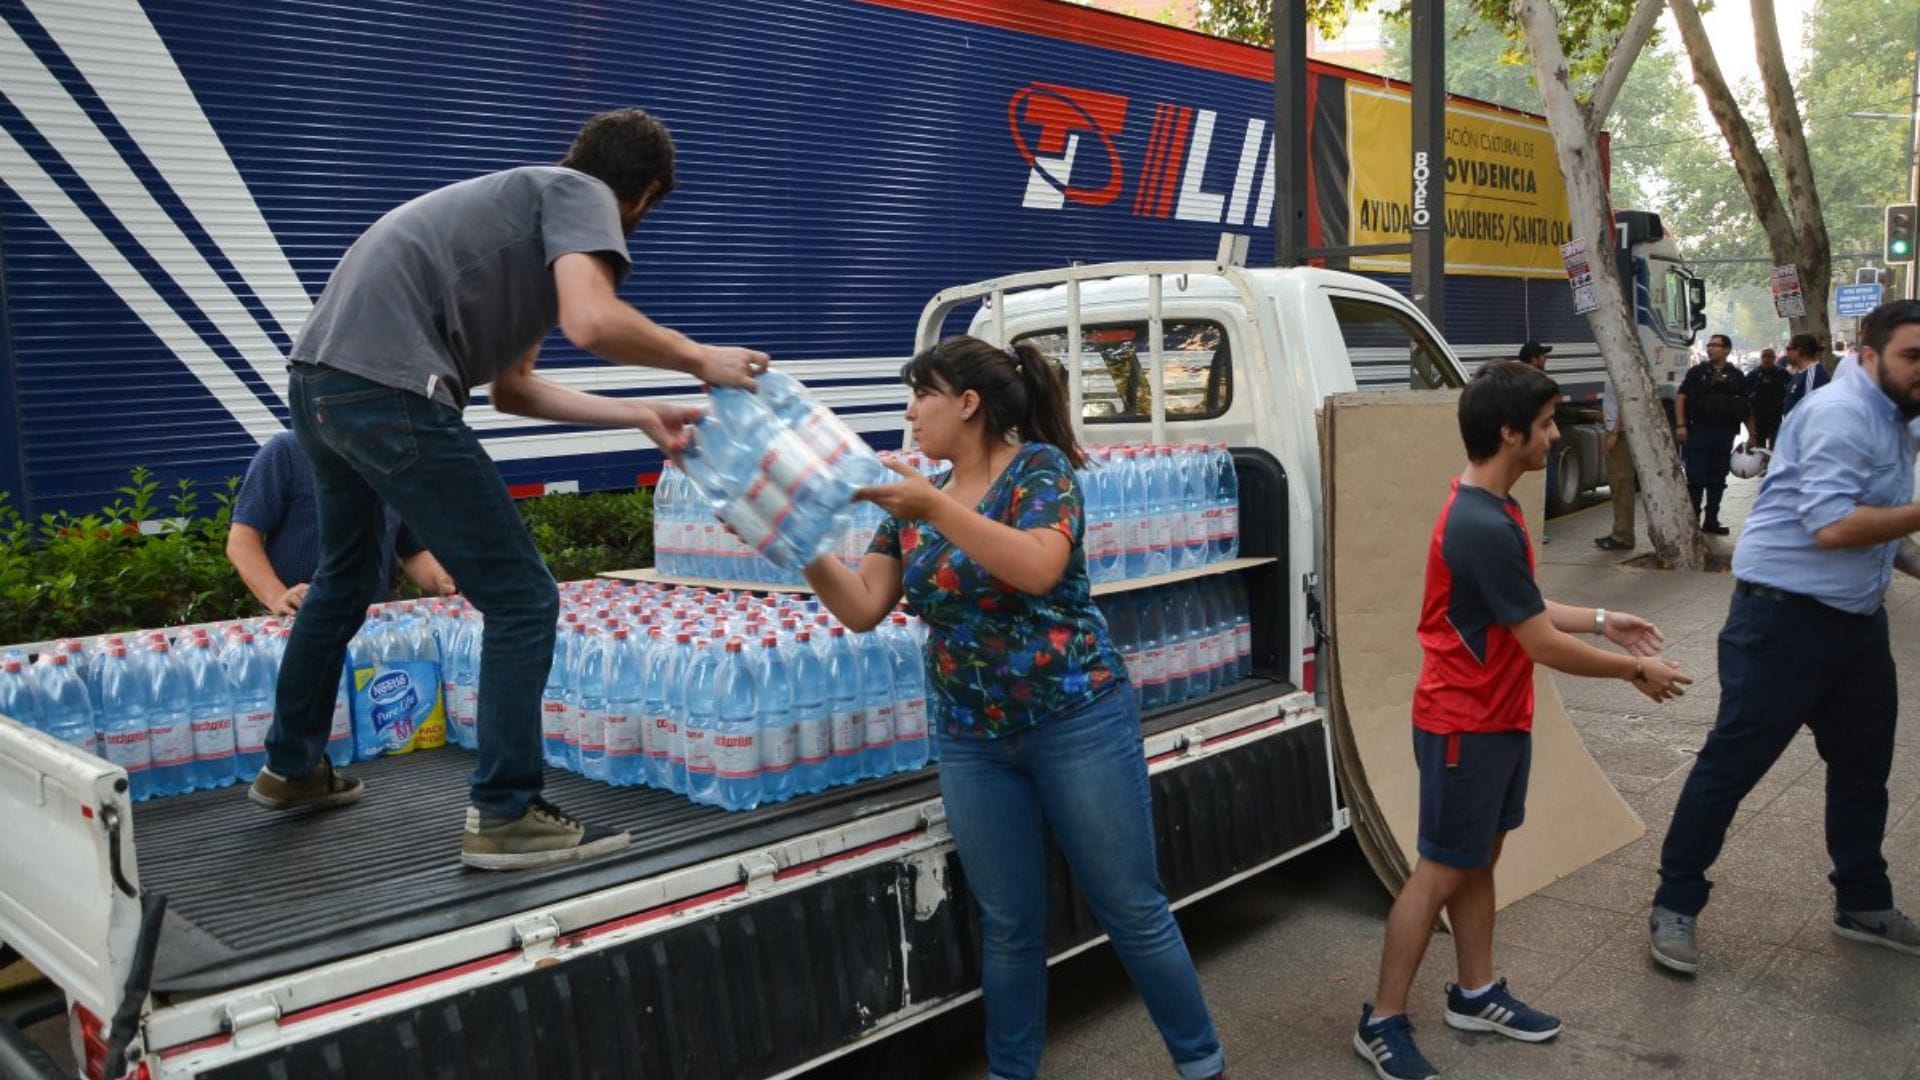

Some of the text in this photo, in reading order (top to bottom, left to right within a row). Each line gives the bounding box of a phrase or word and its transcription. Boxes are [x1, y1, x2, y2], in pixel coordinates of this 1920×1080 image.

[1445, 127, 1536, 159] ACIÓN CULTURAL DE
[1413, 151, 1430, 225] BOXEO
[1445, 157, 1536, 193] OVIDENCIA
[1360, 198, 1412, 234] AYUDA
[1444, 207, 1548, 247] UQUENES/SANTA
[376, 695, 416, 725] Pure Life
